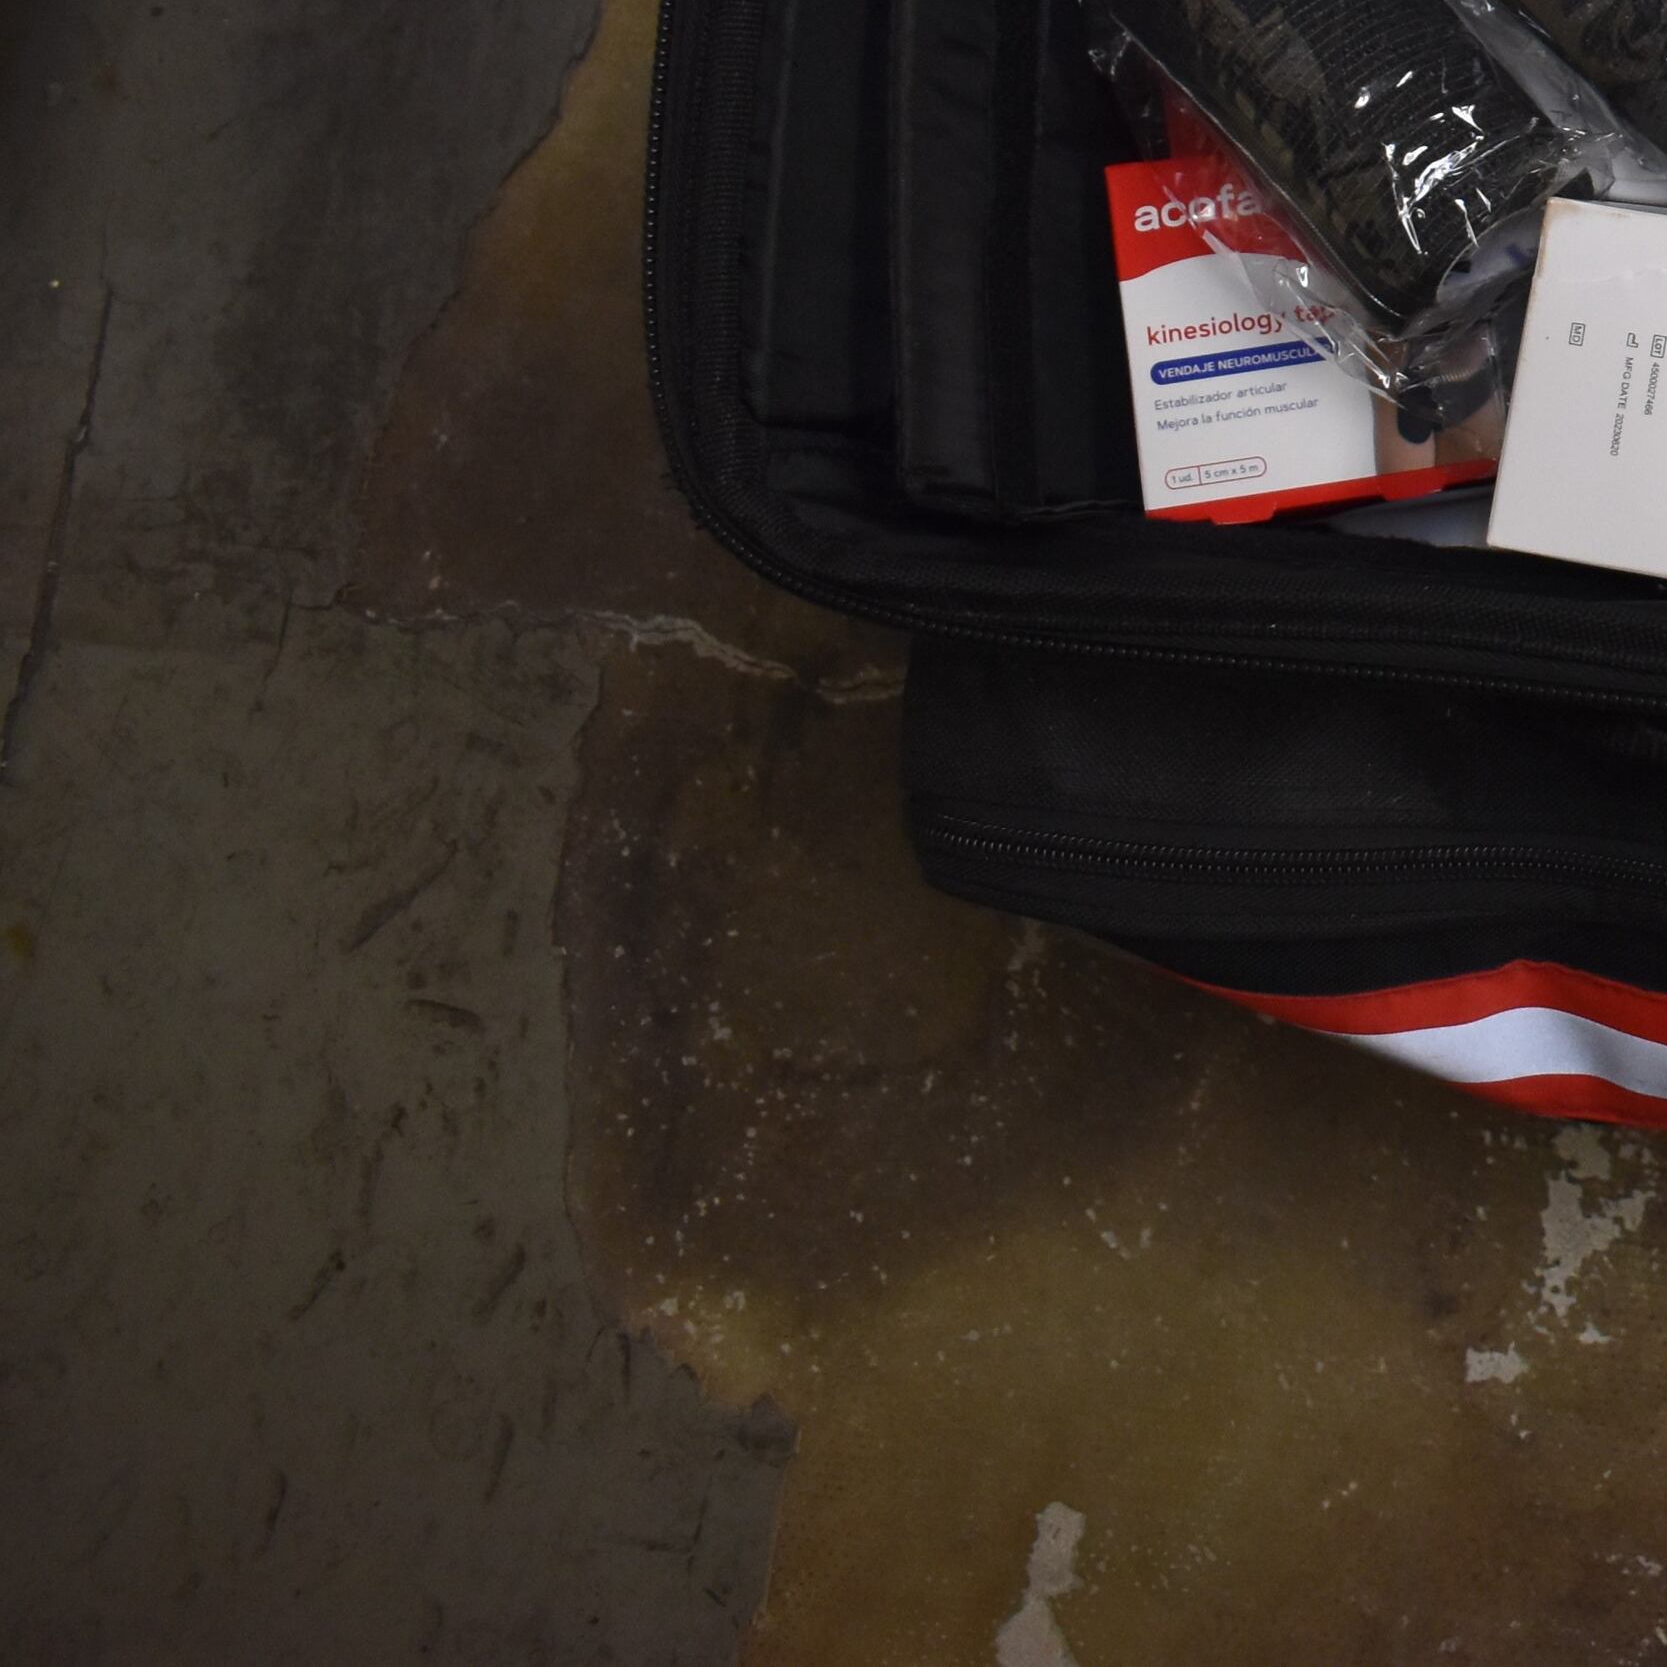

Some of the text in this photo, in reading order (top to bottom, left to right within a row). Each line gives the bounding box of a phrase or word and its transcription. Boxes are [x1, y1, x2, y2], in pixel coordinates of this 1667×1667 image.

[1134, 184, 1263, 232] acofa
[1146, 308, 1284, 346] kinesiology
[1571, 325, 1583, 343] MD
[1653, 337, 1664, 355] LOT
[1158, 361, 1216, 379] VENDAJE
[1622, 356, 1634, 380] MFG
[1154, 382, 1288, 411] Estabilizador articular
[1617, 381, 1630, 409] DATE
[1156, 397, 1319, 433] Mejora la función muscular
